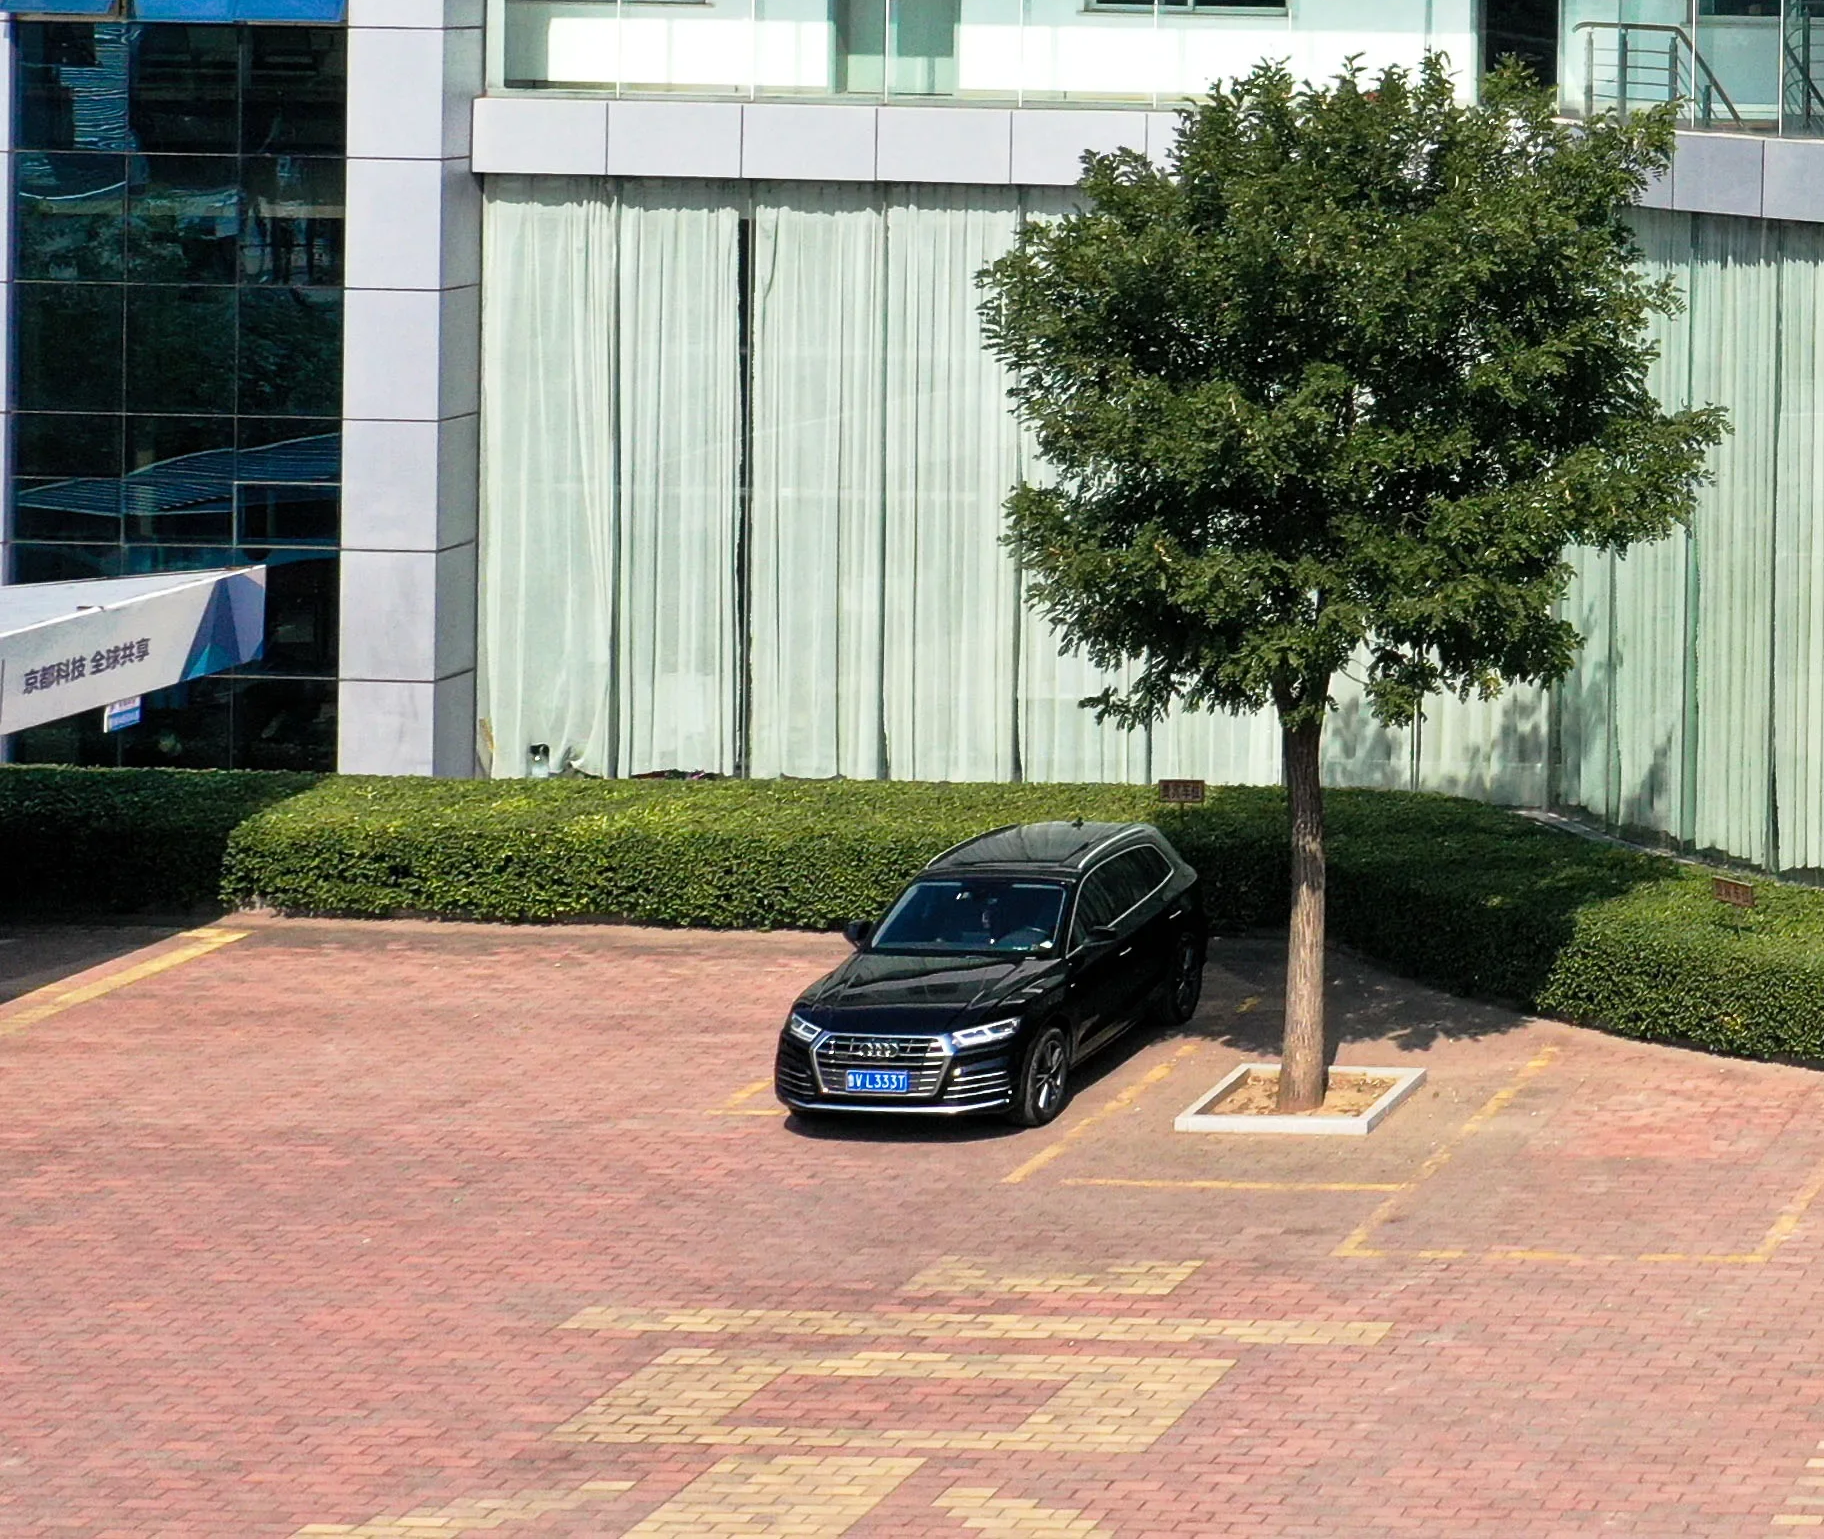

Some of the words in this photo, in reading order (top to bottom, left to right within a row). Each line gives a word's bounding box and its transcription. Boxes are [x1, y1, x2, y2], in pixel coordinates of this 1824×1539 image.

[22, 655, 87, 695] 京都科技
[89, 637, 151, 676] 全球共享
